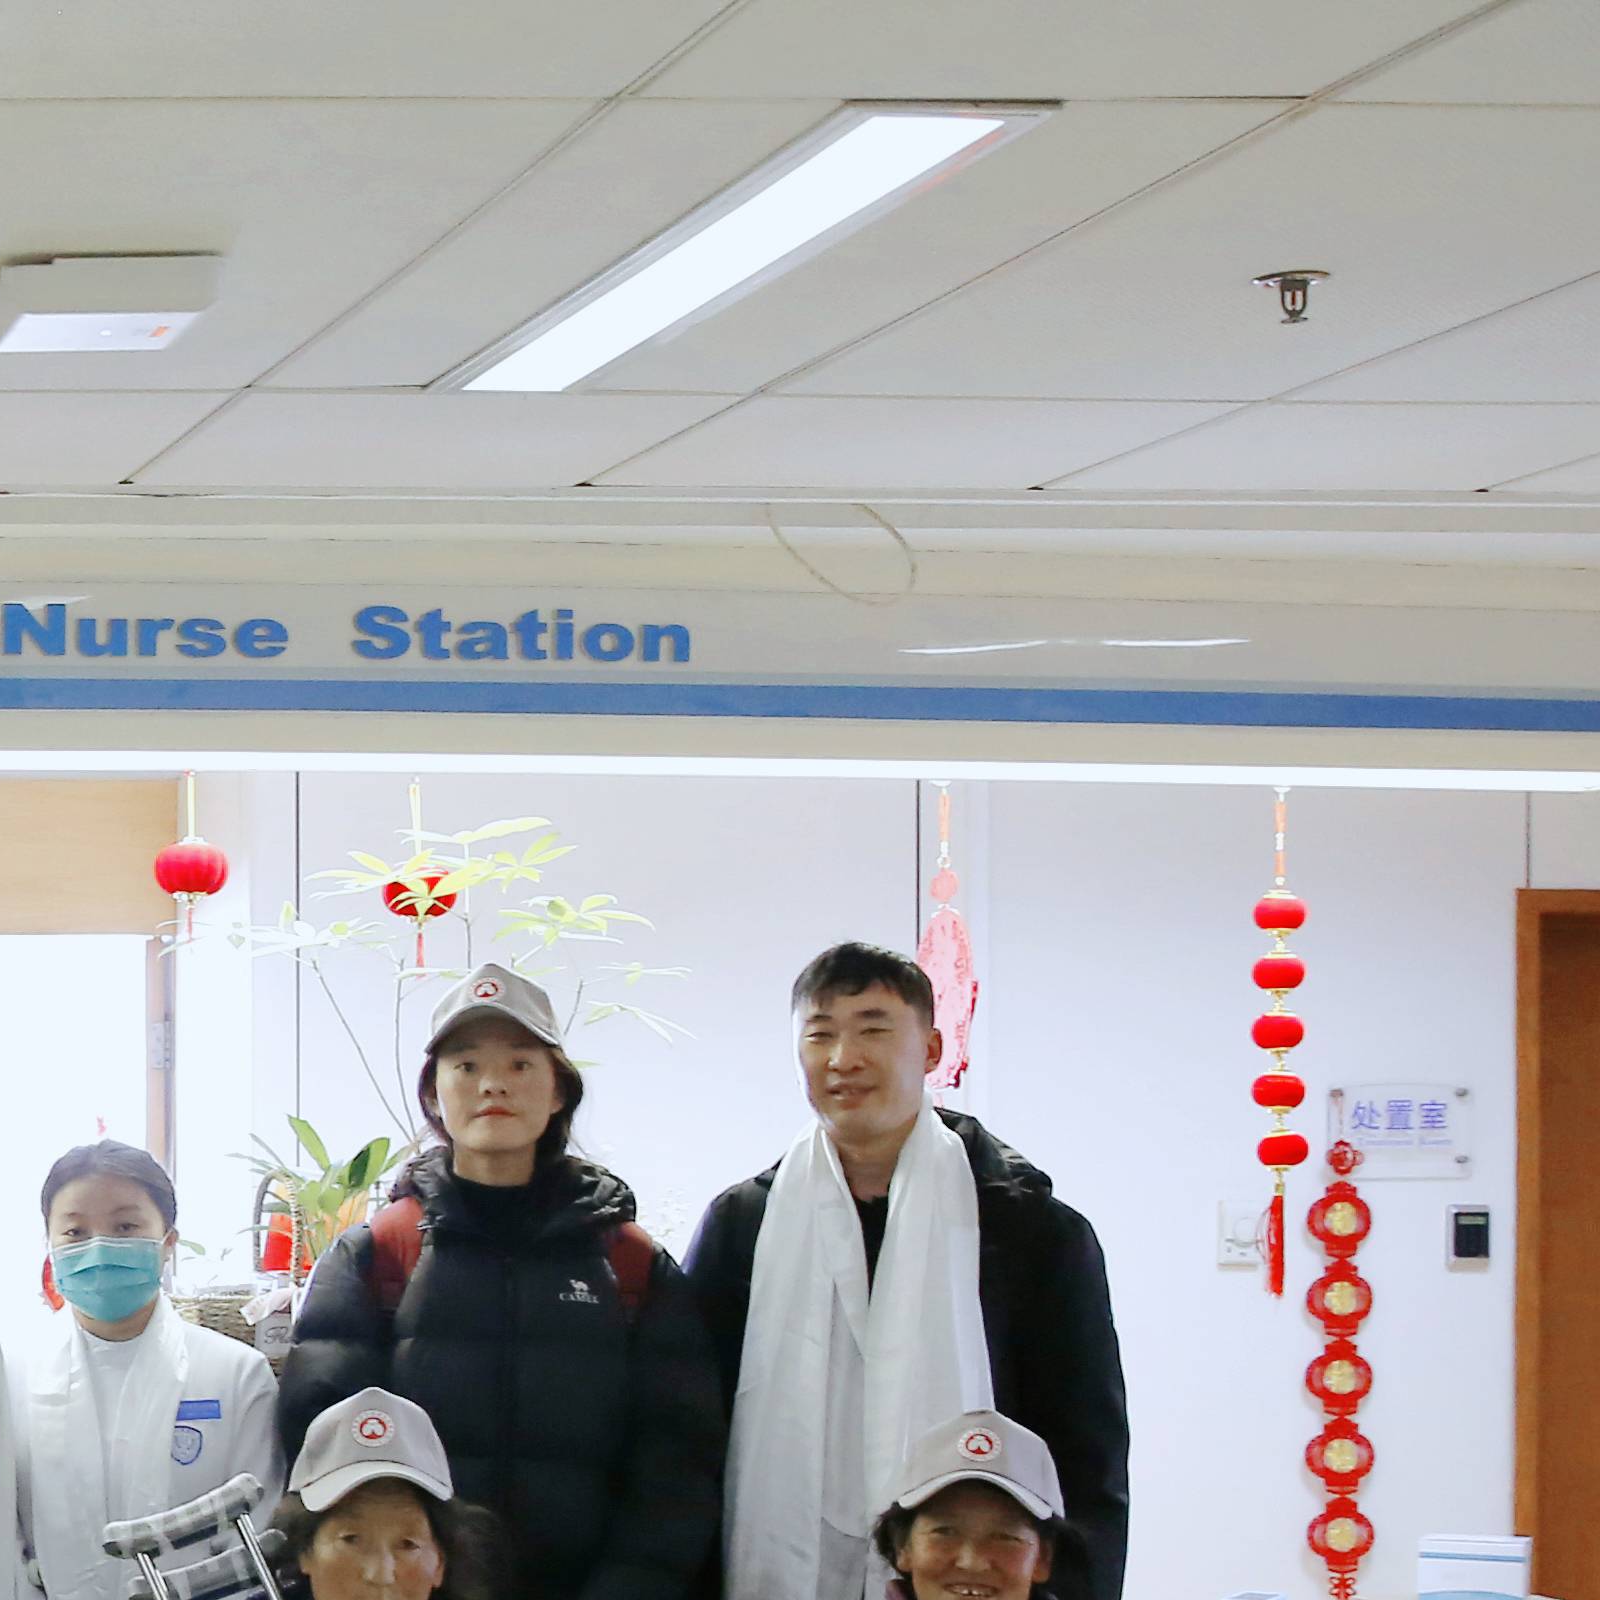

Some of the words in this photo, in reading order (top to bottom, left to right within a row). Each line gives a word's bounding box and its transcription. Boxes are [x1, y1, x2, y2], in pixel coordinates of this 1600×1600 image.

[1, 602, 289, 658] Nurse
[351, 605, 692, 663] Station
[1352, 1099, 1448, 1130] 处置室
